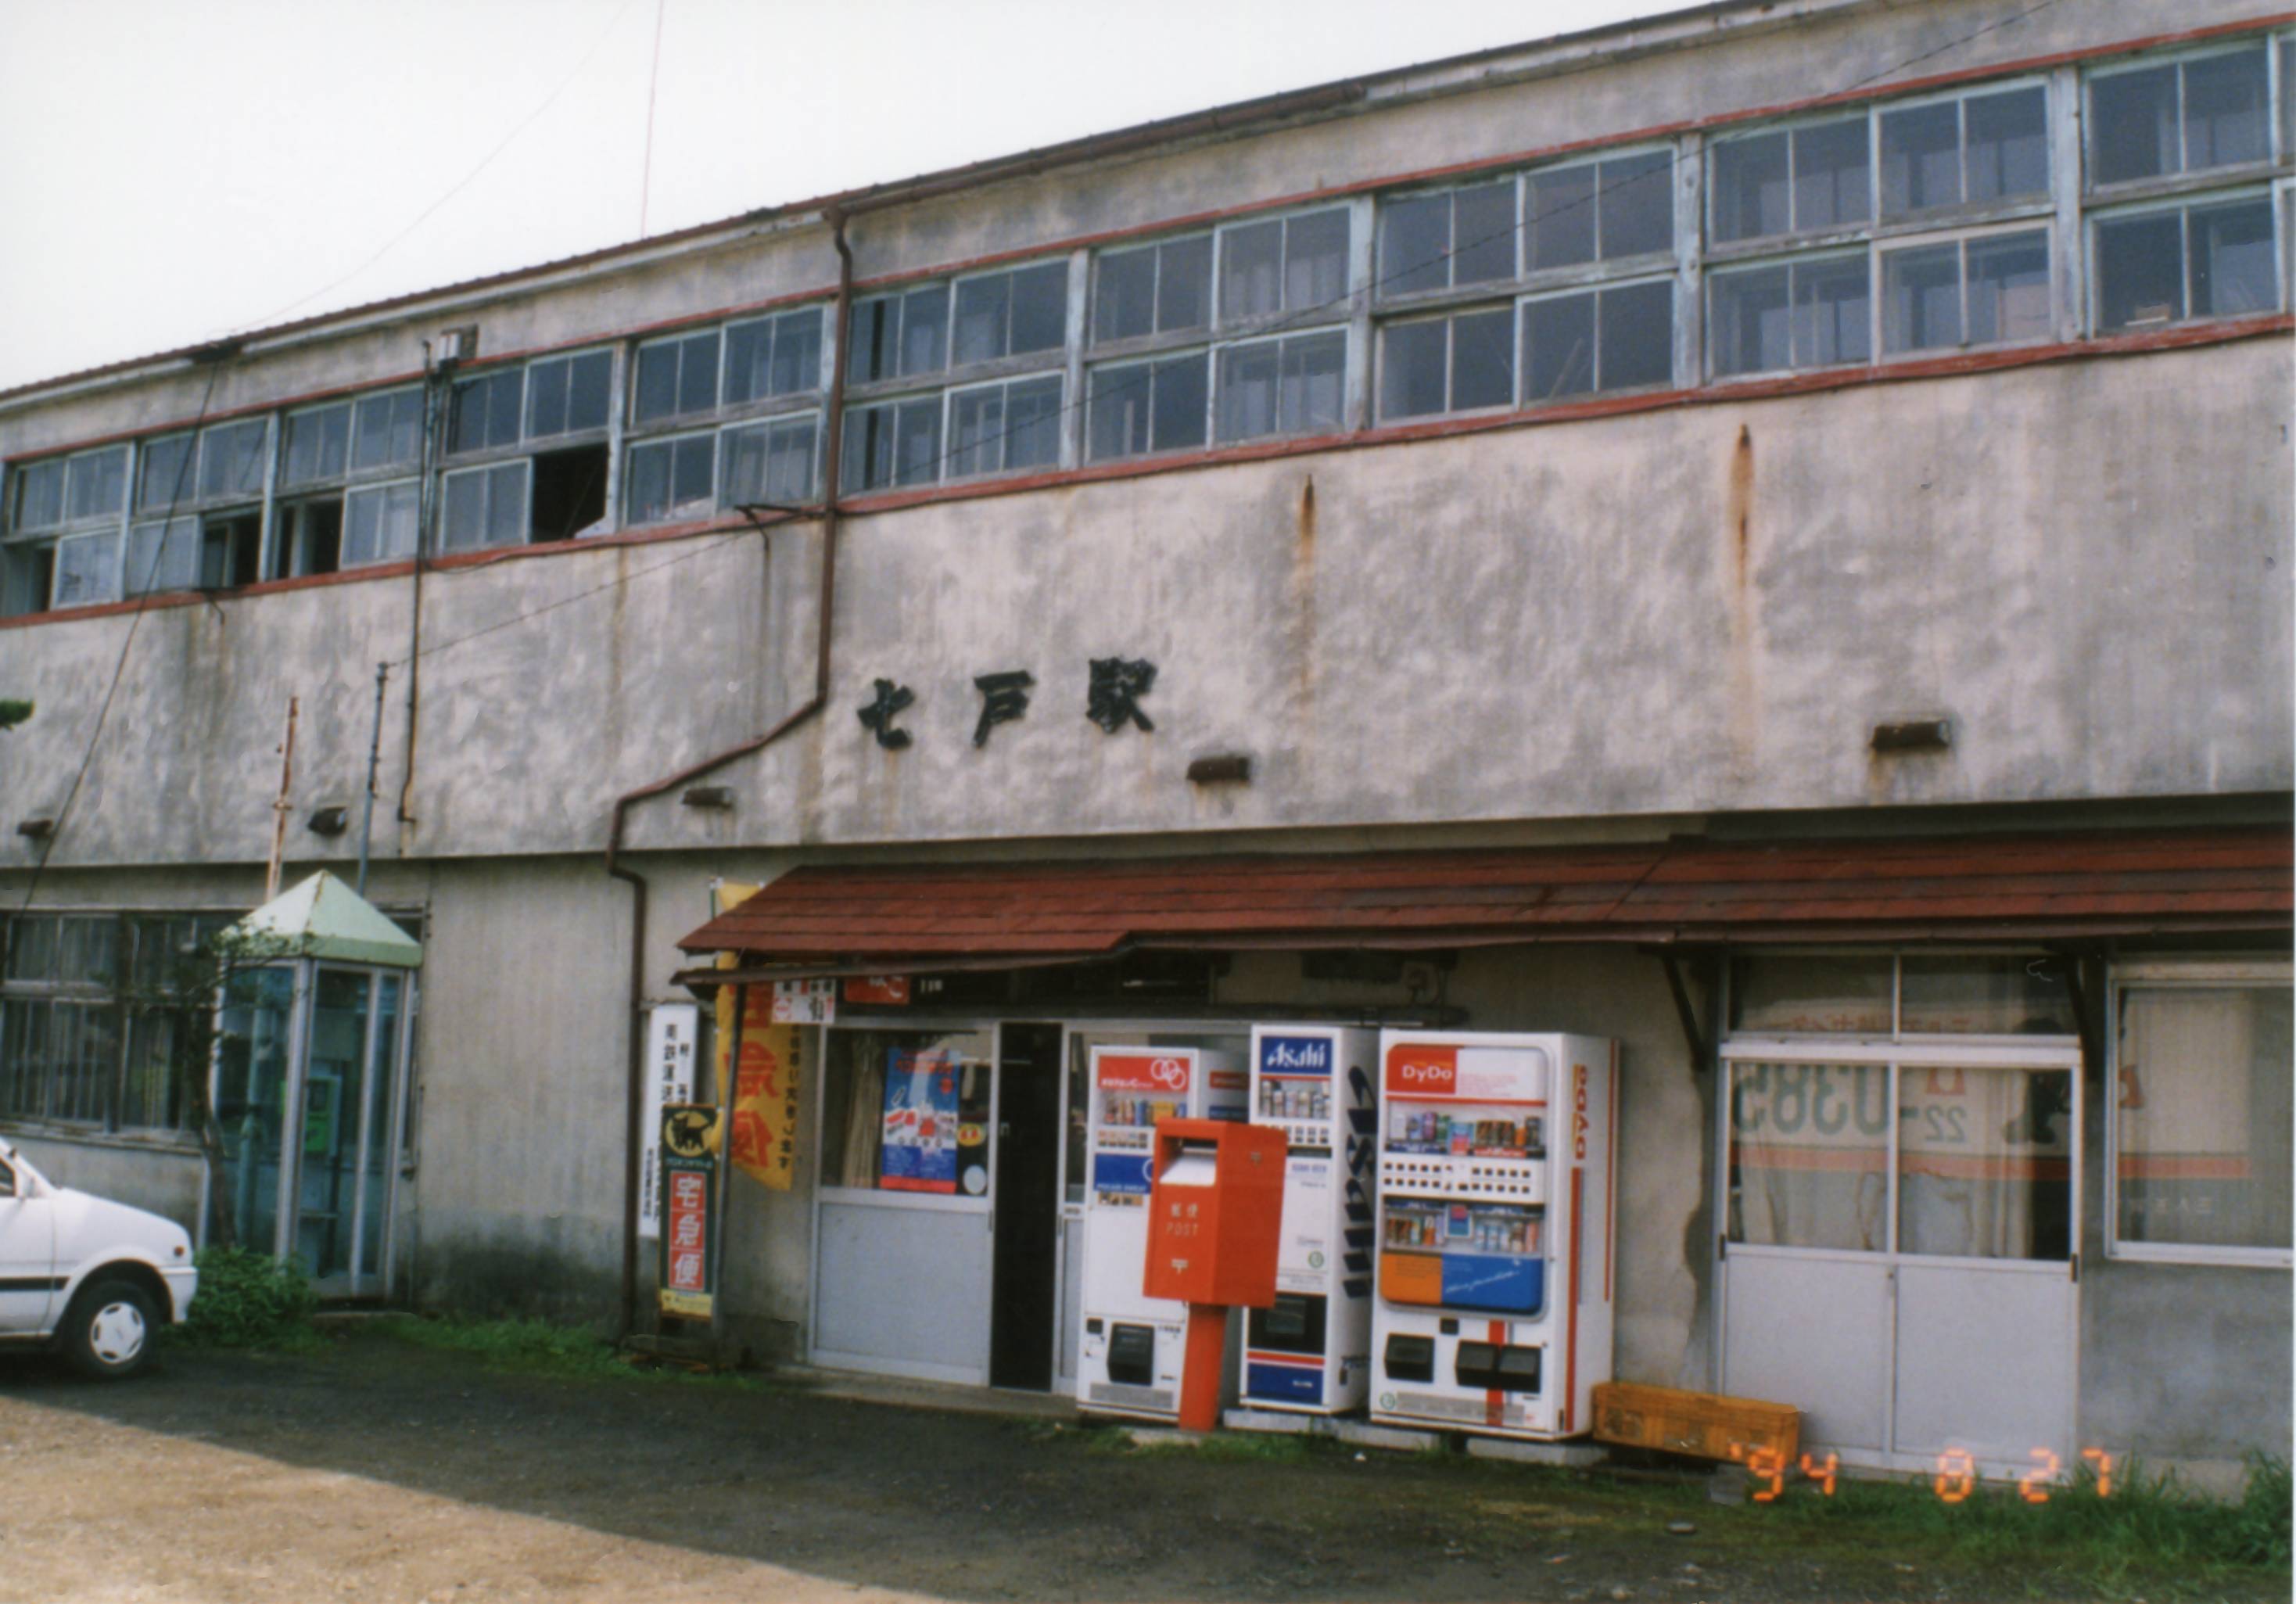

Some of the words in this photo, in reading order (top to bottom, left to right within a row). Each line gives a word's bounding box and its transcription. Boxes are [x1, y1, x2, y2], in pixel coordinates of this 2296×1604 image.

[857, 656, 1159, 749] 七戸駅
[1266, 1041, 1326, 1068] Asahi
[1401, 1064, 1453, 1083] DyDo
[674, 1177, 701, 1284] 宅急便
[1165, 1222, 1200, 1236] POST
